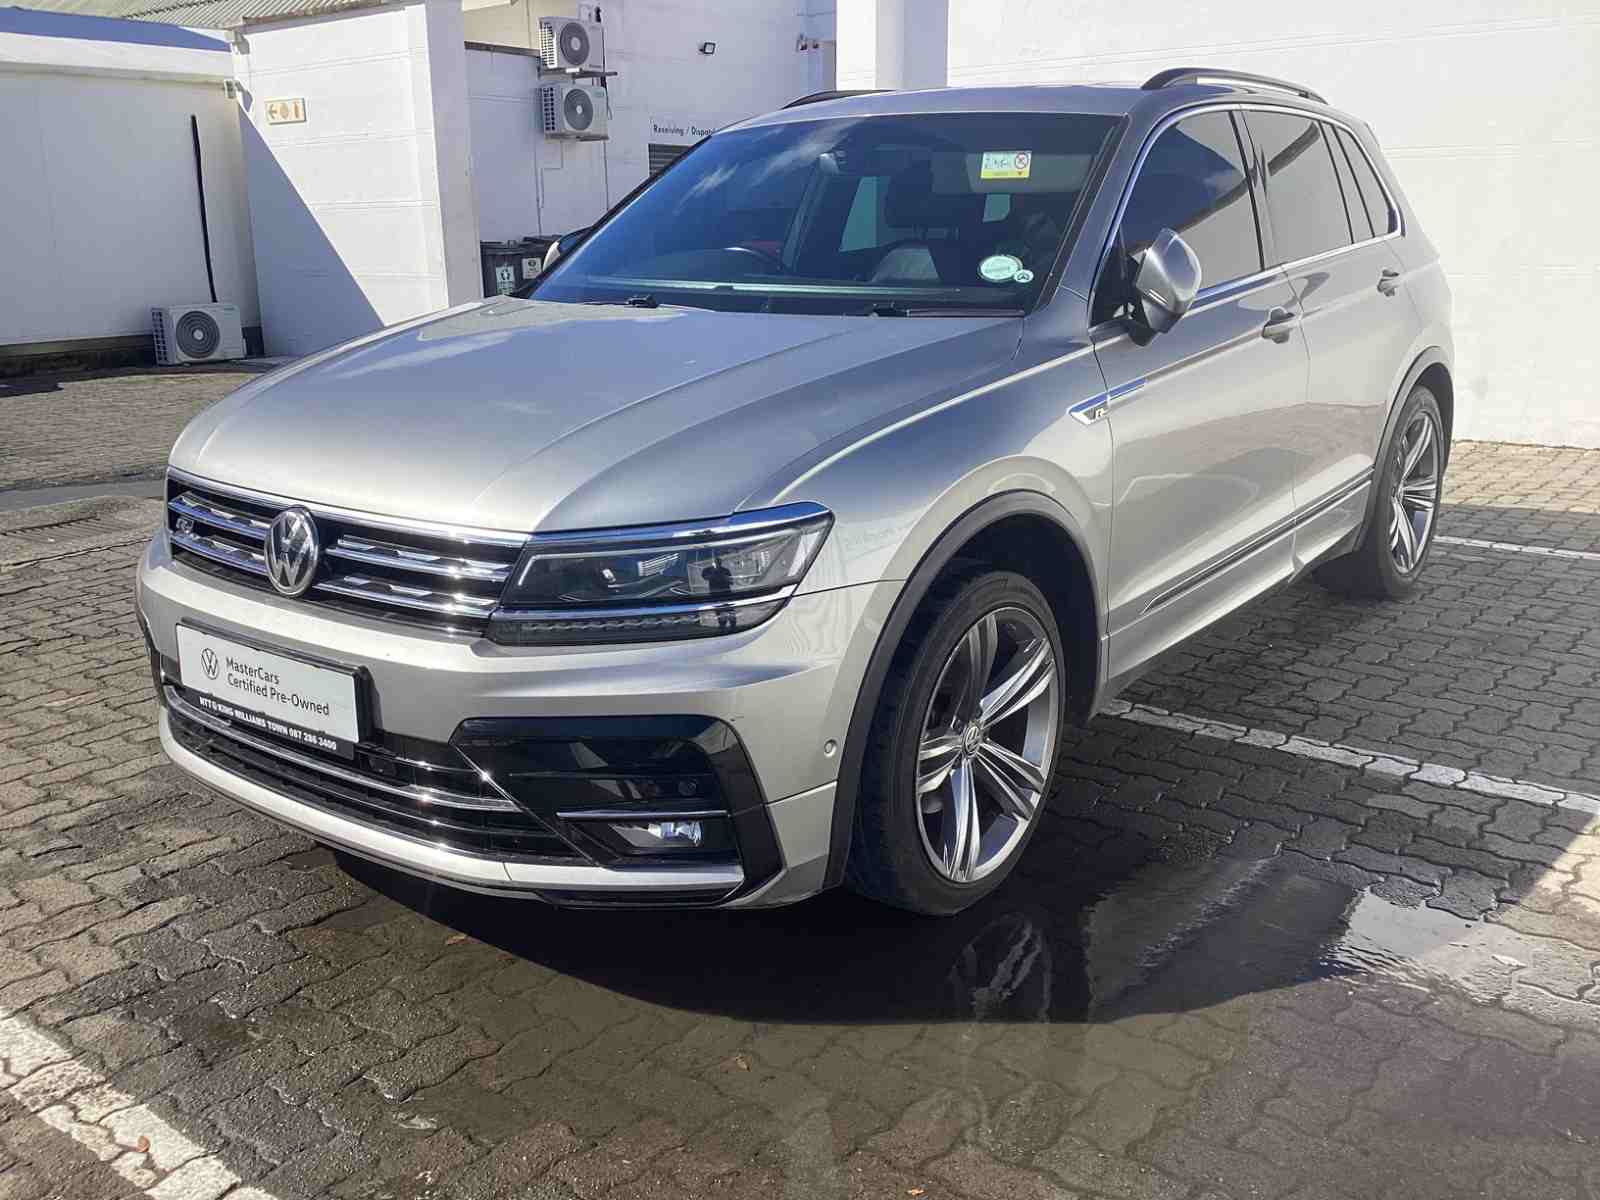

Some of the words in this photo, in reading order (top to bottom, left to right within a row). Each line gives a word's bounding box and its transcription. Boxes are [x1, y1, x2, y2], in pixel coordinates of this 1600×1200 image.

[653, 124, 684, 136] Receiving
[226, 656, 280, 684] MasterCars
[227, 673, 268, 697] Certified
[270, 687, 329, 715] Pre-Owned
[266, 720, 288, 736] TOWN
